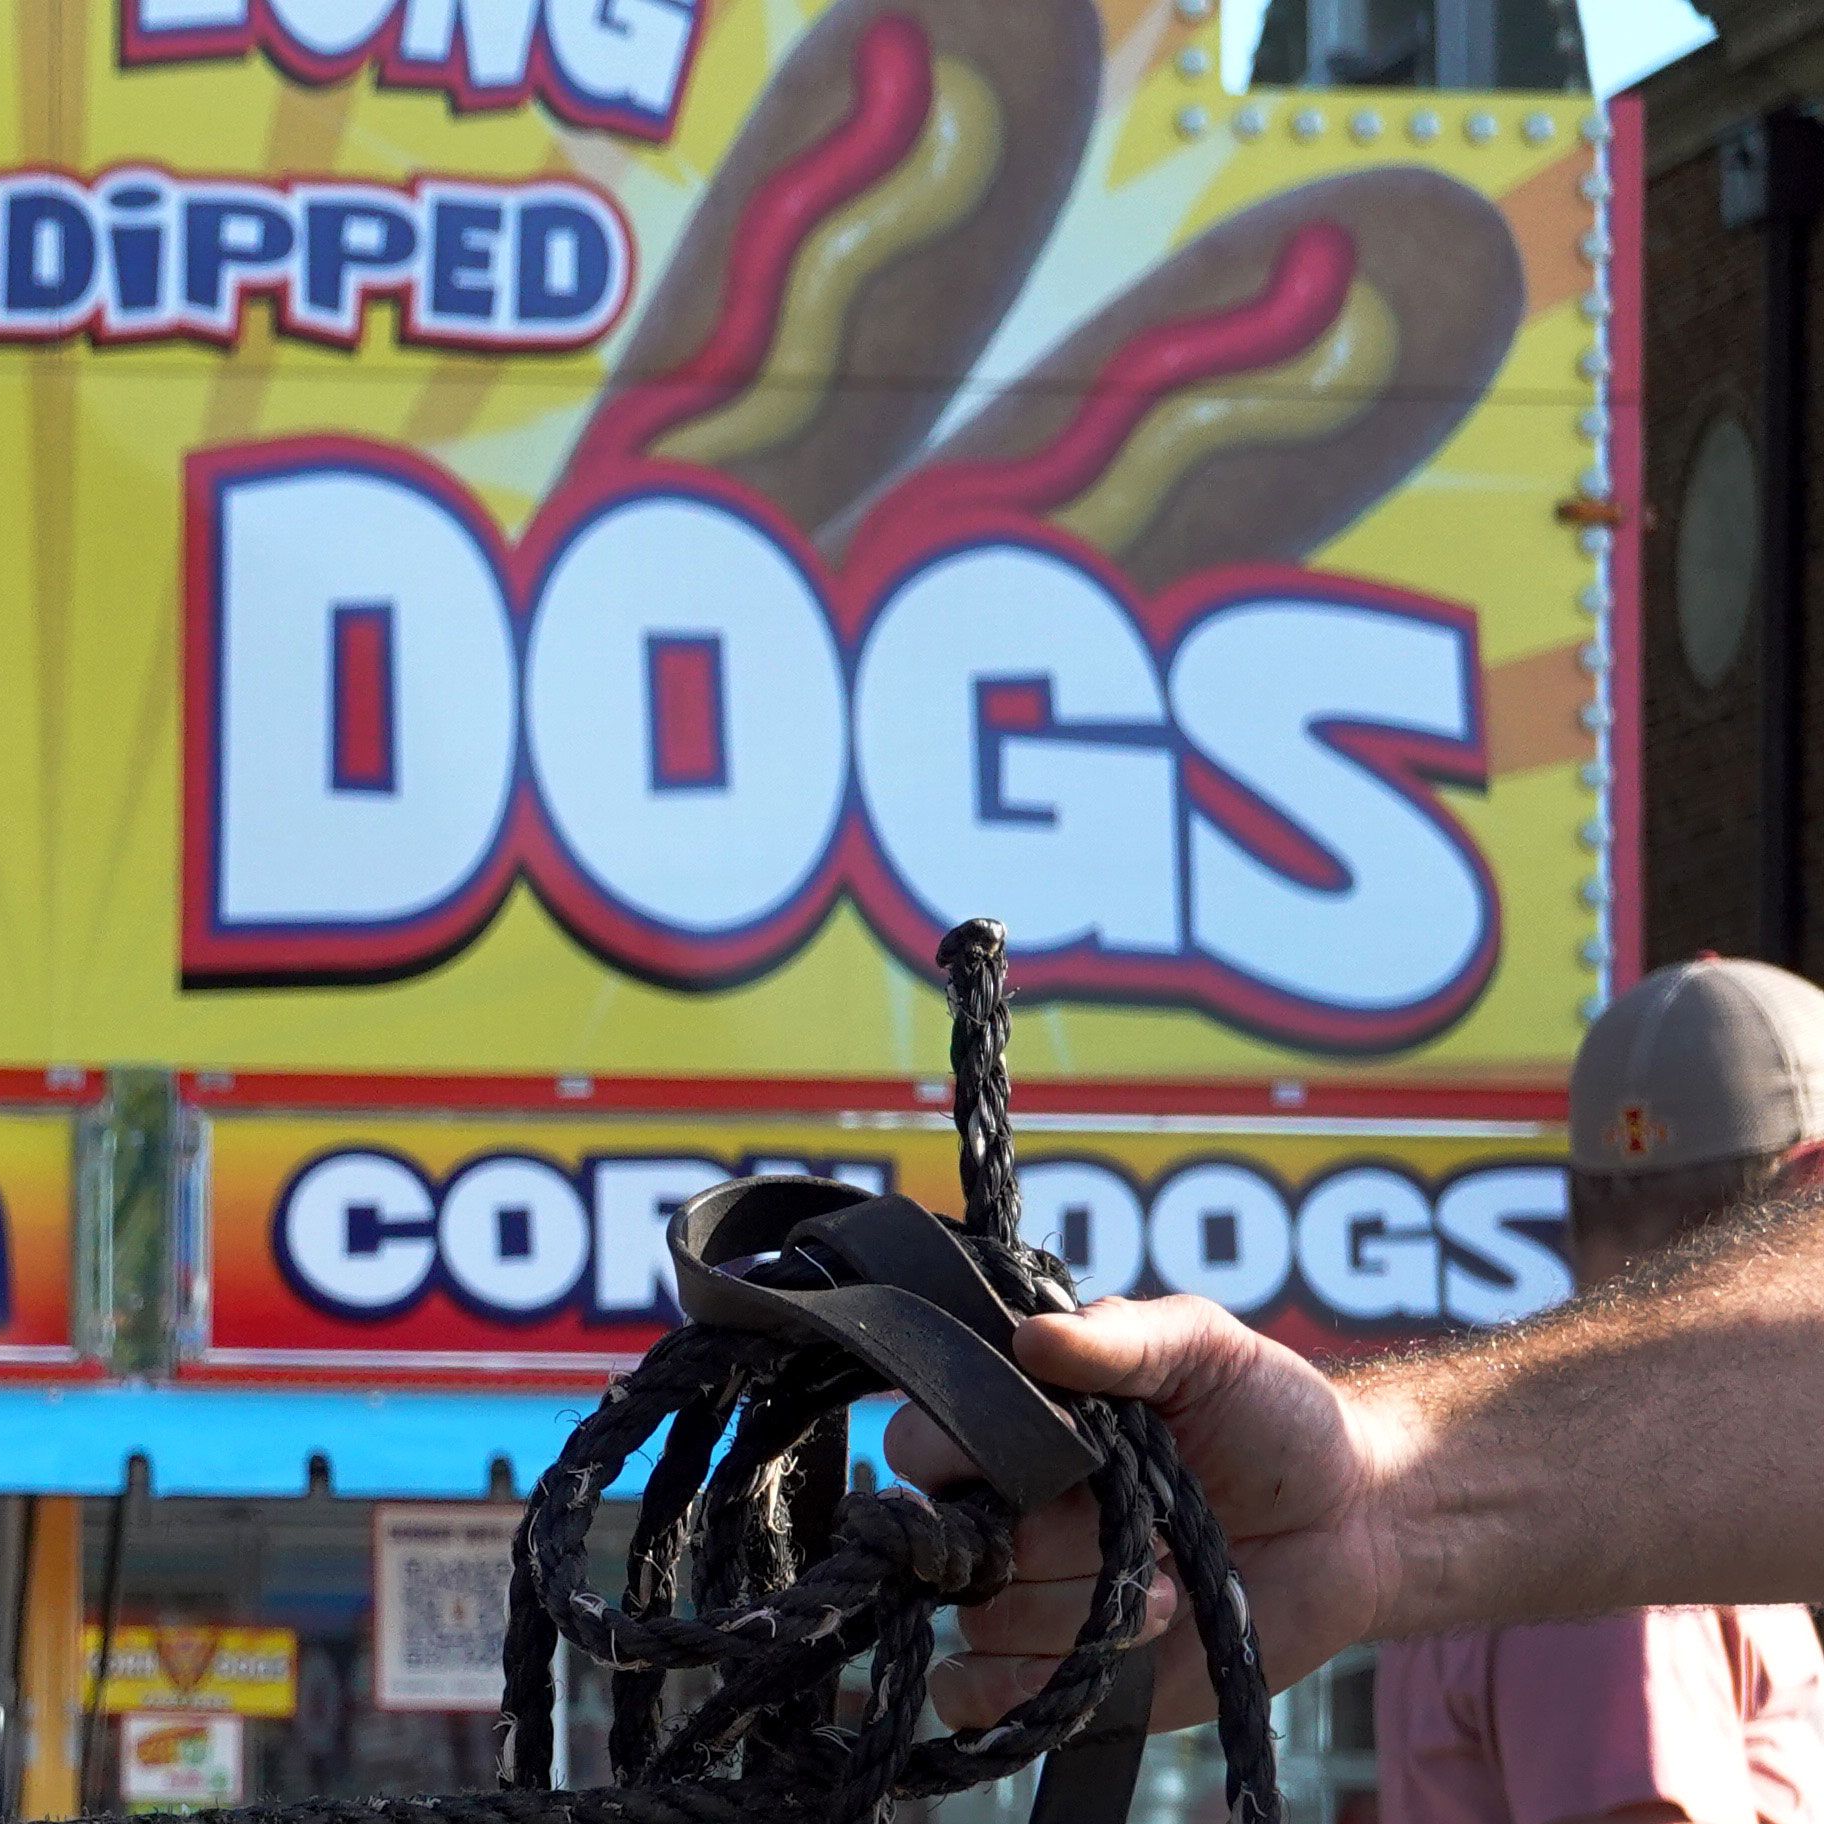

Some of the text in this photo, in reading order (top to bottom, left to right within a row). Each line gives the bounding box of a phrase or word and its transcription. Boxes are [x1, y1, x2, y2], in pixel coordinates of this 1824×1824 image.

[207, 458, 1497, 1020] DOGS
[277, 1146, 1574, 1330] COR DOGS
